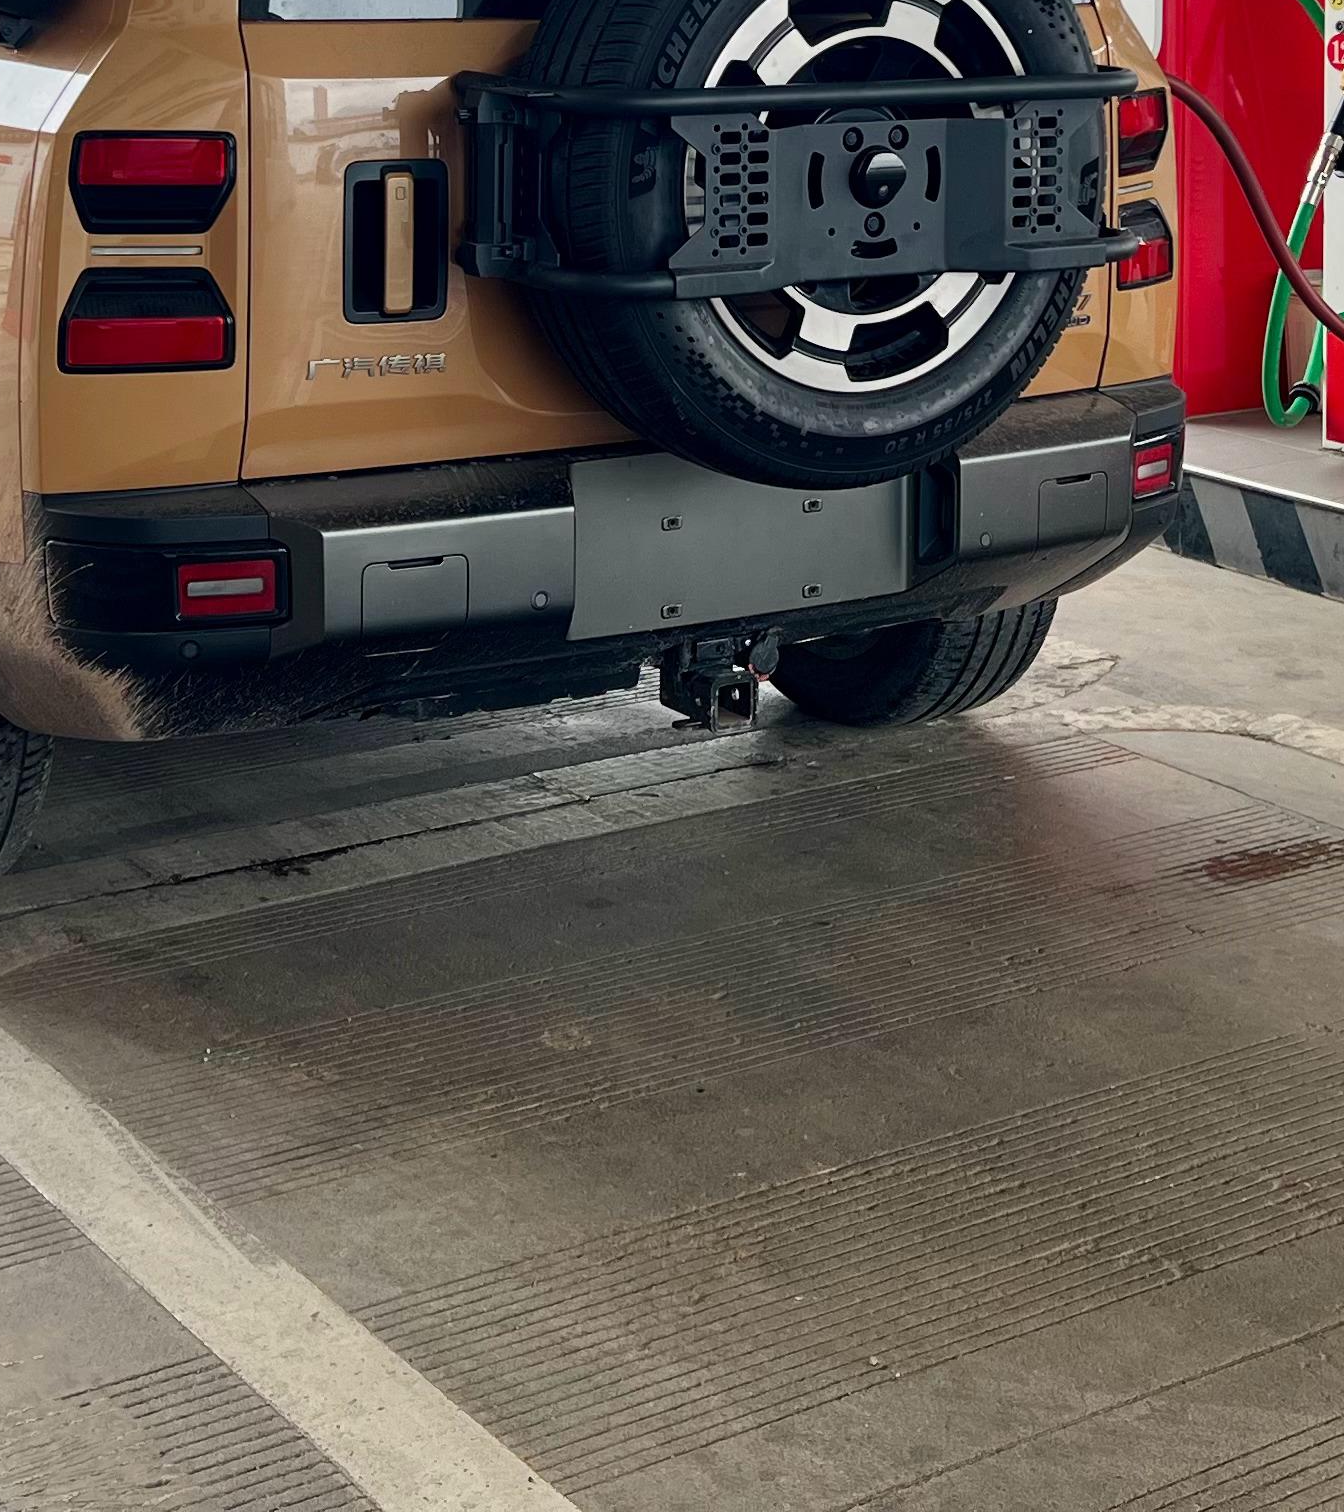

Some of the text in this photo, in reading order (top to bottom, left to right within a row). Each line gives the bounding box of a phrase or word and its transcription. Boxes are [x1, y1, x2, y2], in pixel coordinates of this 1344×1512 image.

[305, 352, 447, 381] 广汽传祺
[884, 436, 908, 455] 20
[915, 430, 927, 445] R
